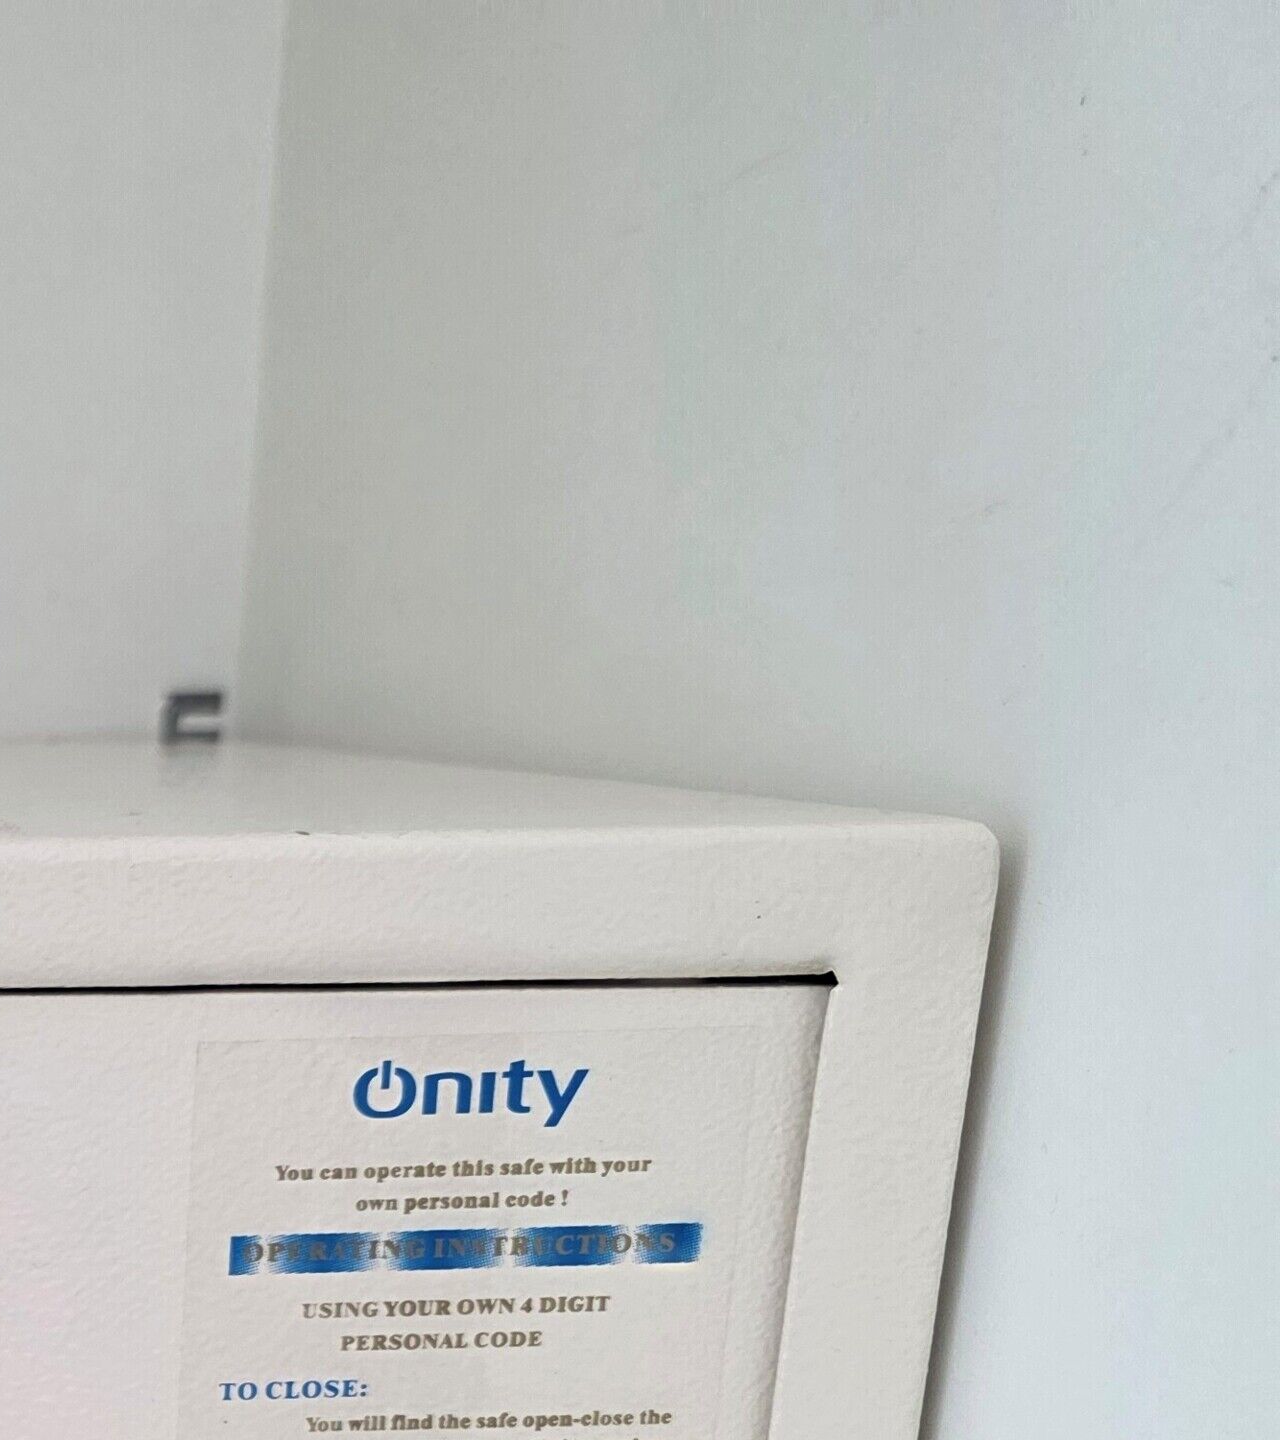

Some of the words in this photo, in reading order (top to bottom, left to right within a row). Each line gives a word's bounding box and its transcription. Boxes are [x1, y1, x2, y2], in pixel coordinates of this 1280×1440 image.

[352, 1059, 589, 1127] Onity
[275, 1165, 313, 1181] You
[319, 1166, 358, 1180] can
[364, 1161, 447, 1183] operate
[452, 1159, 494, 1178] this
[499, 1158, 544, 1176] safe
[549, 1157, 596, 1174] with
[601, 1159, 652, 1177] your
[355, 1198, 398, 1212] own
[403, 1191, 500, 1215] personal
[505, 1191, 555, 1208] code
[302, 1301, 378, 1319] USING
[385, 1299, 451, 1317] YOUR
[457, 1298, 516, 1315] OWN
[520, 1297, 533, 1313] 4
[538, 1295, 611, 1313] DIGIT
[340, 1332, 468, 1351] PERSONAL
[474, 1330, 543, 1348] CODE
[218, 1381, 258, 1401] TO
[265, 1379, 368, 1400] CLOSE:
[306, 1417, 343, 1433] You
[348, 1415, 386, 1432] will
[390, 1414, 433, 1430] find
[438, 1413, 471, 1429] the
[476, 1412, 518, 1429] safe
[522, 1410, 634, 1431] open-close
[639, 1409, 672, 1425] the
